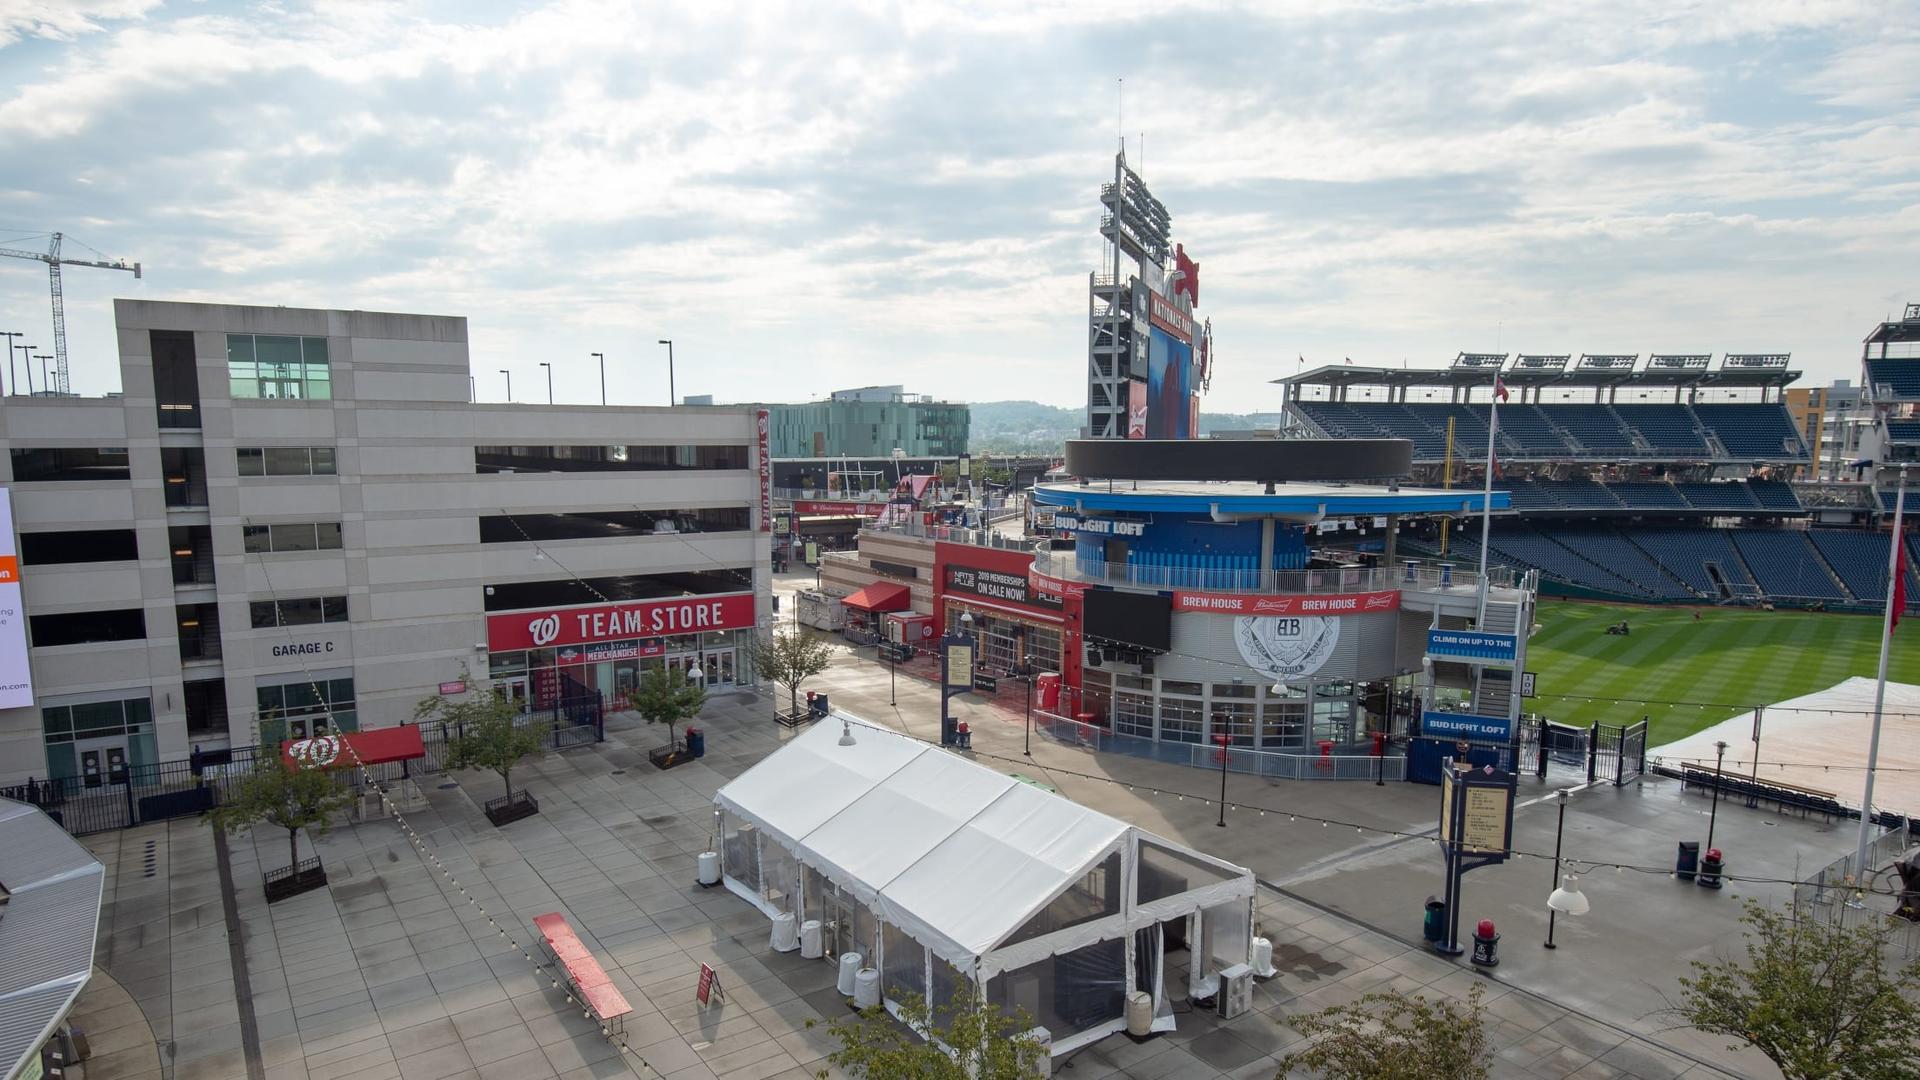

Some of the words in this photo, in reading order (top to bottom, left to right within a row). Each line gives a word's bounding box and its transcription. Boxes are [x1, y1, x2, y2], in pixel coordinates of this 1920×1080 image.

[1154, 299, 1181, 329] NATIONALS
[1182, 317, 1192, 337] PARK
[760, 438, 769, 477] TEAM
[761, 481, 770, 528] STORE
[1056, 516, 1077, 530] BUD
[1112, 521, 1145, 537] LOFT
[954, 571, 975, 581] NATS
[954, 578, 975, 588] PLUS
[978, 571, 990, 581] 2019
[990, 573, 1025, 587] MEMBERSHIPS
[977, 582, 988, 595] ON
[988, 584, 1005, 598] SALE
[1005, 587, 1025, 602] NOW!
[1038, 592, 1063, 604] PLUS
[1183, 597, 1208, 608] BREW
[1211, 598, 1243, 610] HOUSE
[1302, 600, 1327, 610] BREW
[1329, 599, 1357, 609] HOUSE
[577, 610, 642, 638] TEAM
[651, 603, 723, 631] STORE
[272, 642, 321, 657] GARAGE
[325, 641, 334, 652] C
[1433, 636, 1457, 644] CLIMB
[1496, 640, 1512, 648] THE
[587, 648, 638, 661] MERCHANDISE
[1430, 720, 1449, 729] BUD
[1450, 722, 1478, 731] LIGHT
[1481, 725, 1506, 735] LOFT
